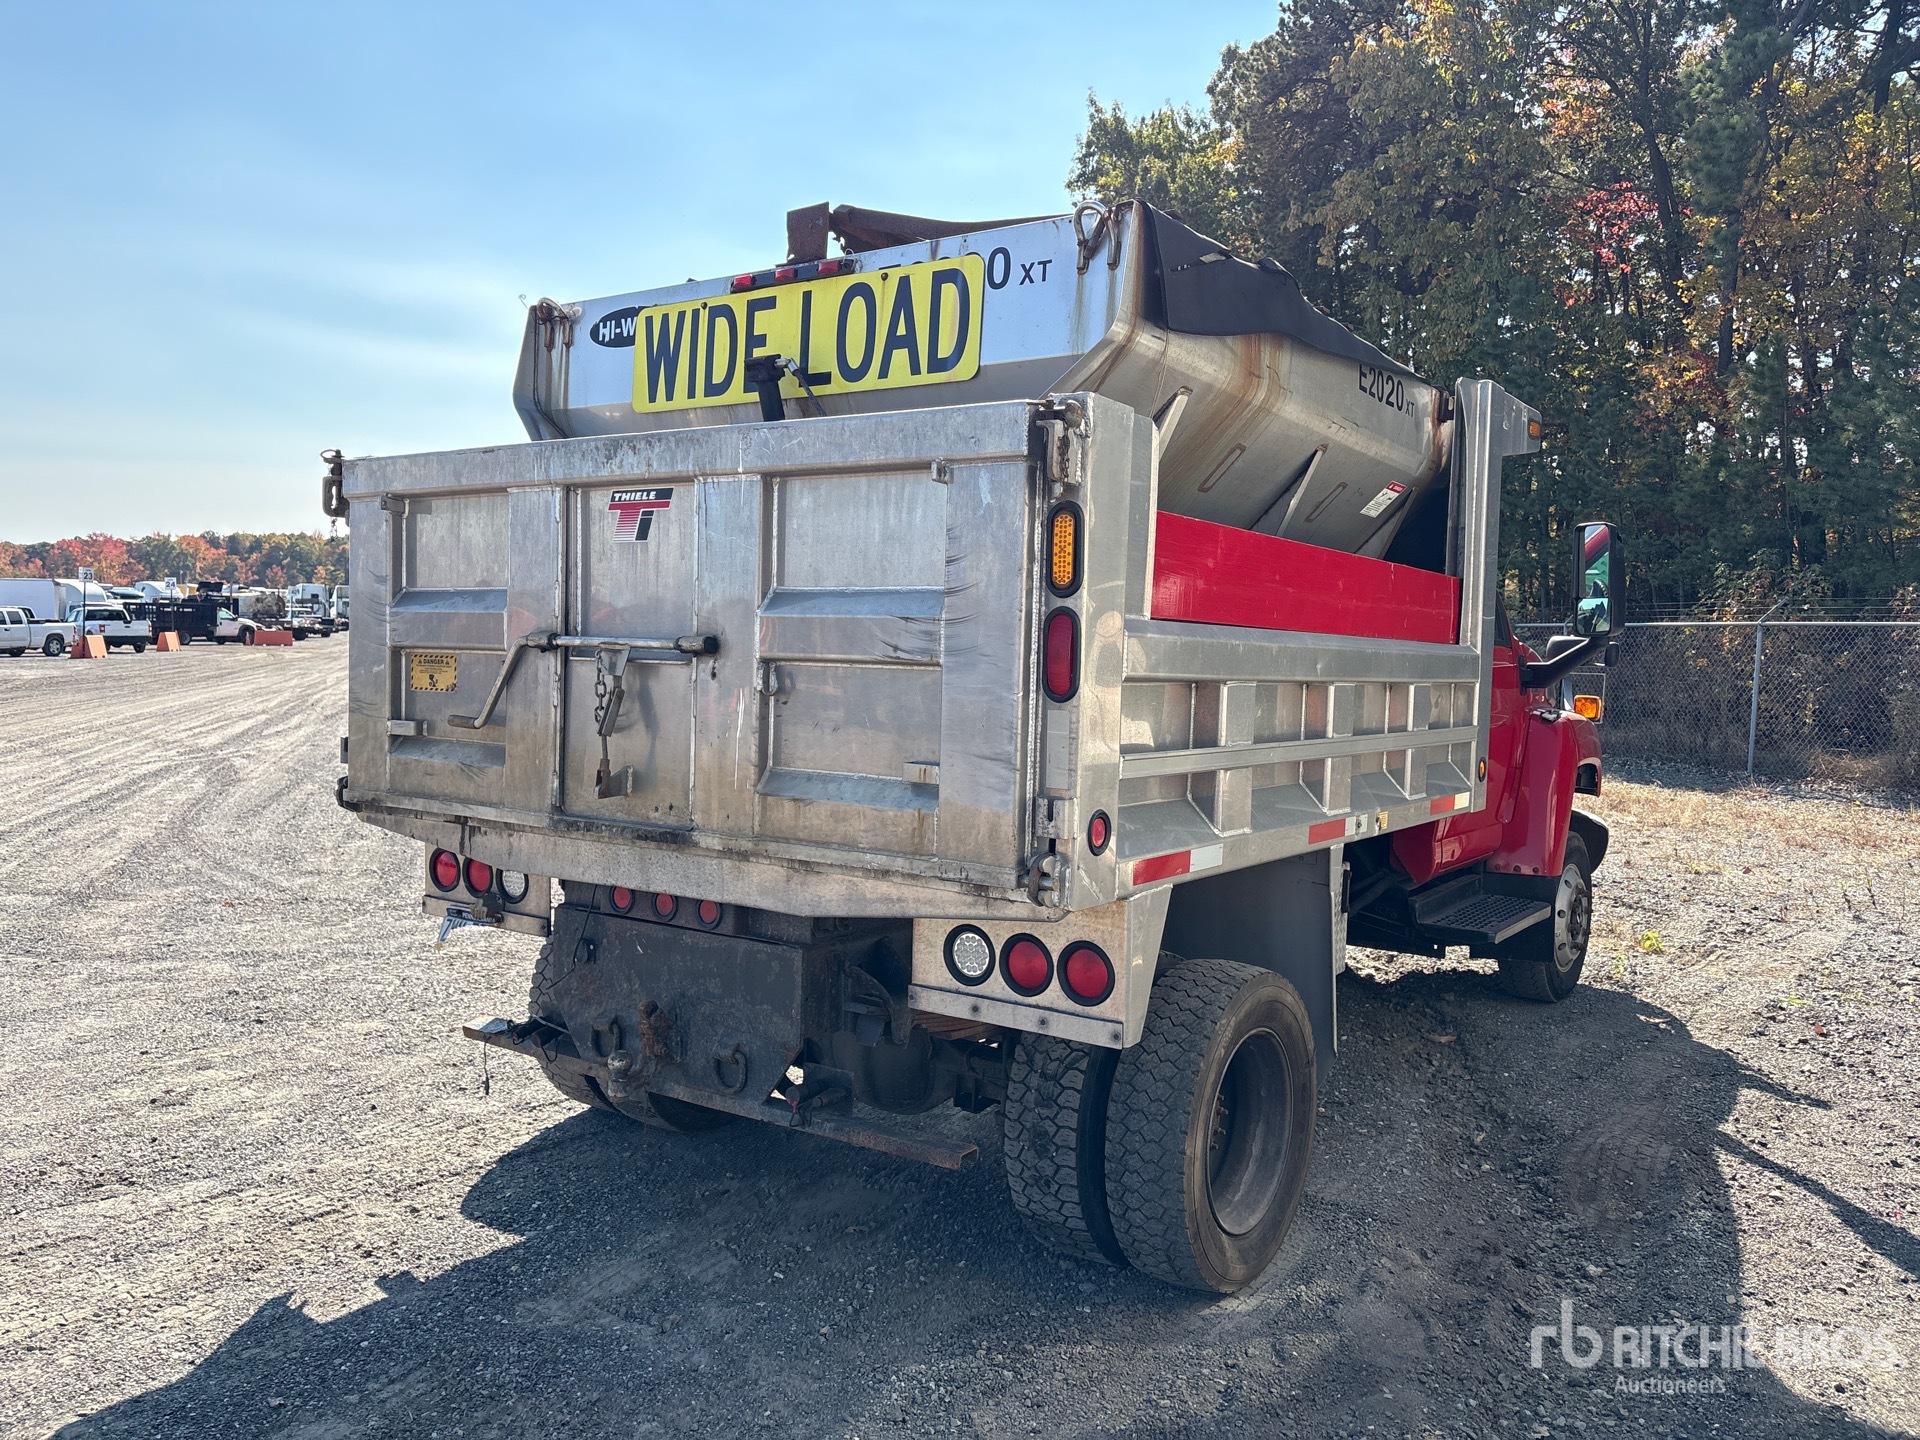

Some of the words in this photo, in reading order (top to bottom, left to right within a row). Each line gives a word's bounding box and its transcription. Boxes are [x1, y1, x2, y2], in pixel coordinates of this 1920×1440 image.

[1019, 259, 1053, 286] XT
[599, 316, 637, 343] HI-W
[645, 295, 776, 404] WIDE
[800, 268, 970, 387] LOAD
[1359, 364, 1404, 412] E2020
[1405, 399, 1415, 418] XT
[613, 491, 657, 502] THIELE
[83, 572, 93, 580] 23
